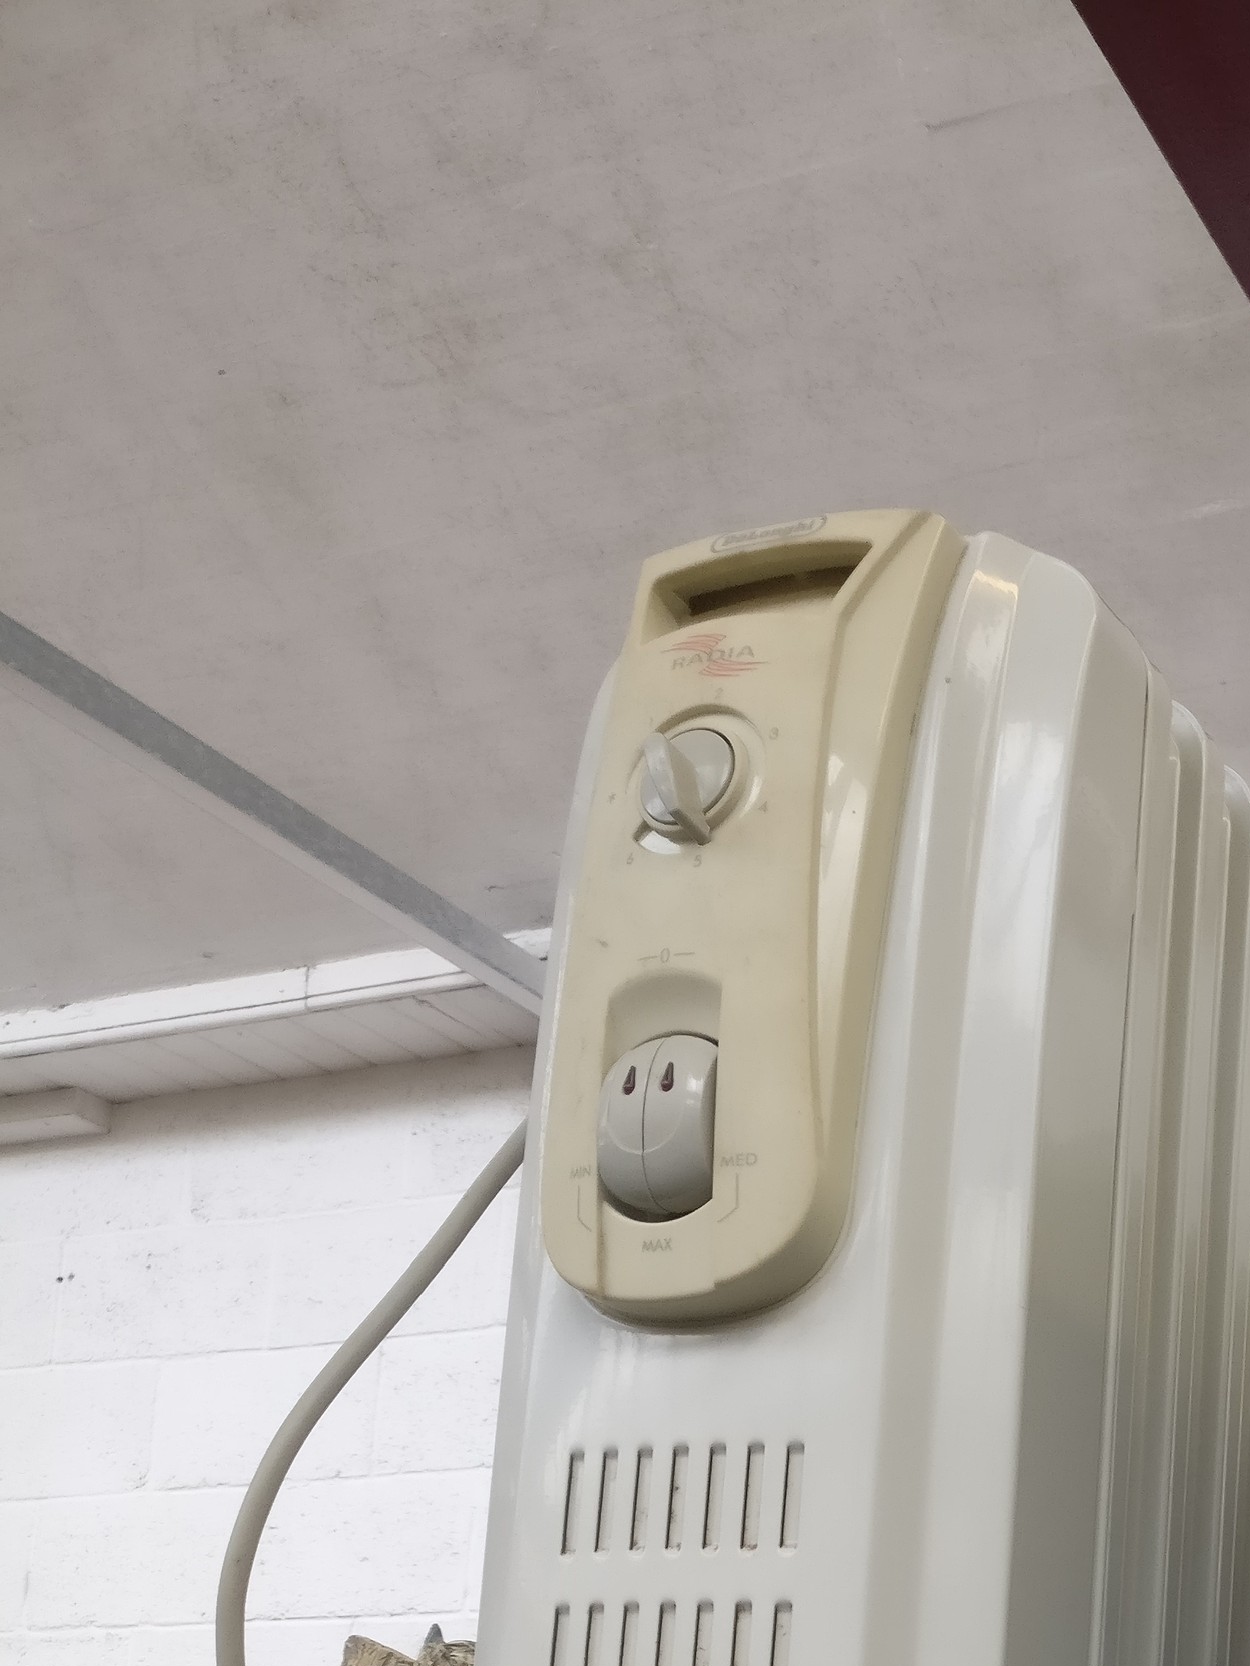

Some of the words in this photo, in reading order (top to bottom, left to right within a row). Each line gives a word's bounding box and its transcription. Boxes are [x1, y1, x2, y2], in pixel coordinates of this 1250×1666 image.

[719, 1152, 758, 1167] MED
[569, 1165, 592, 1180] MIN
[641, 1238, 673, 1252] MAX
